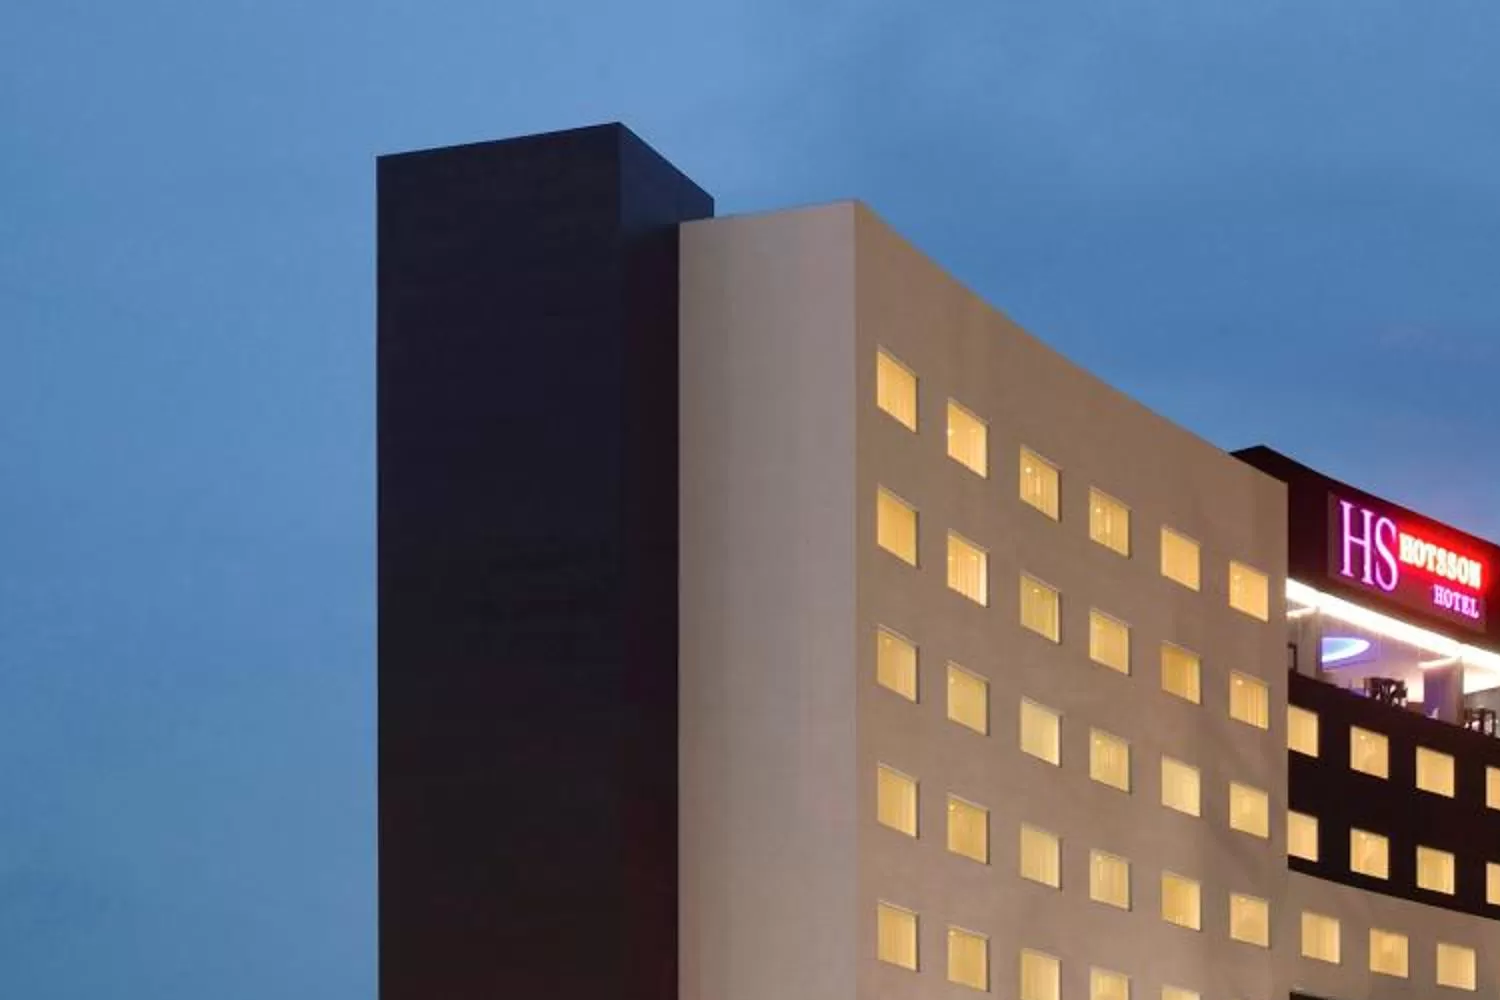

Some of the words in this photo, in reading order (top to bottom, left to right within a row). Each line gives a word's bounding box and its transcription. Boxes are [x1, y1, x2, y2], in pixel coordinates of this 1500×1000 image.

[1339, 499, 1398, 591] HS
[1399, 531, 1482, 589] HOTSSON
[1433, 583, 1479, 619] HOTEL
